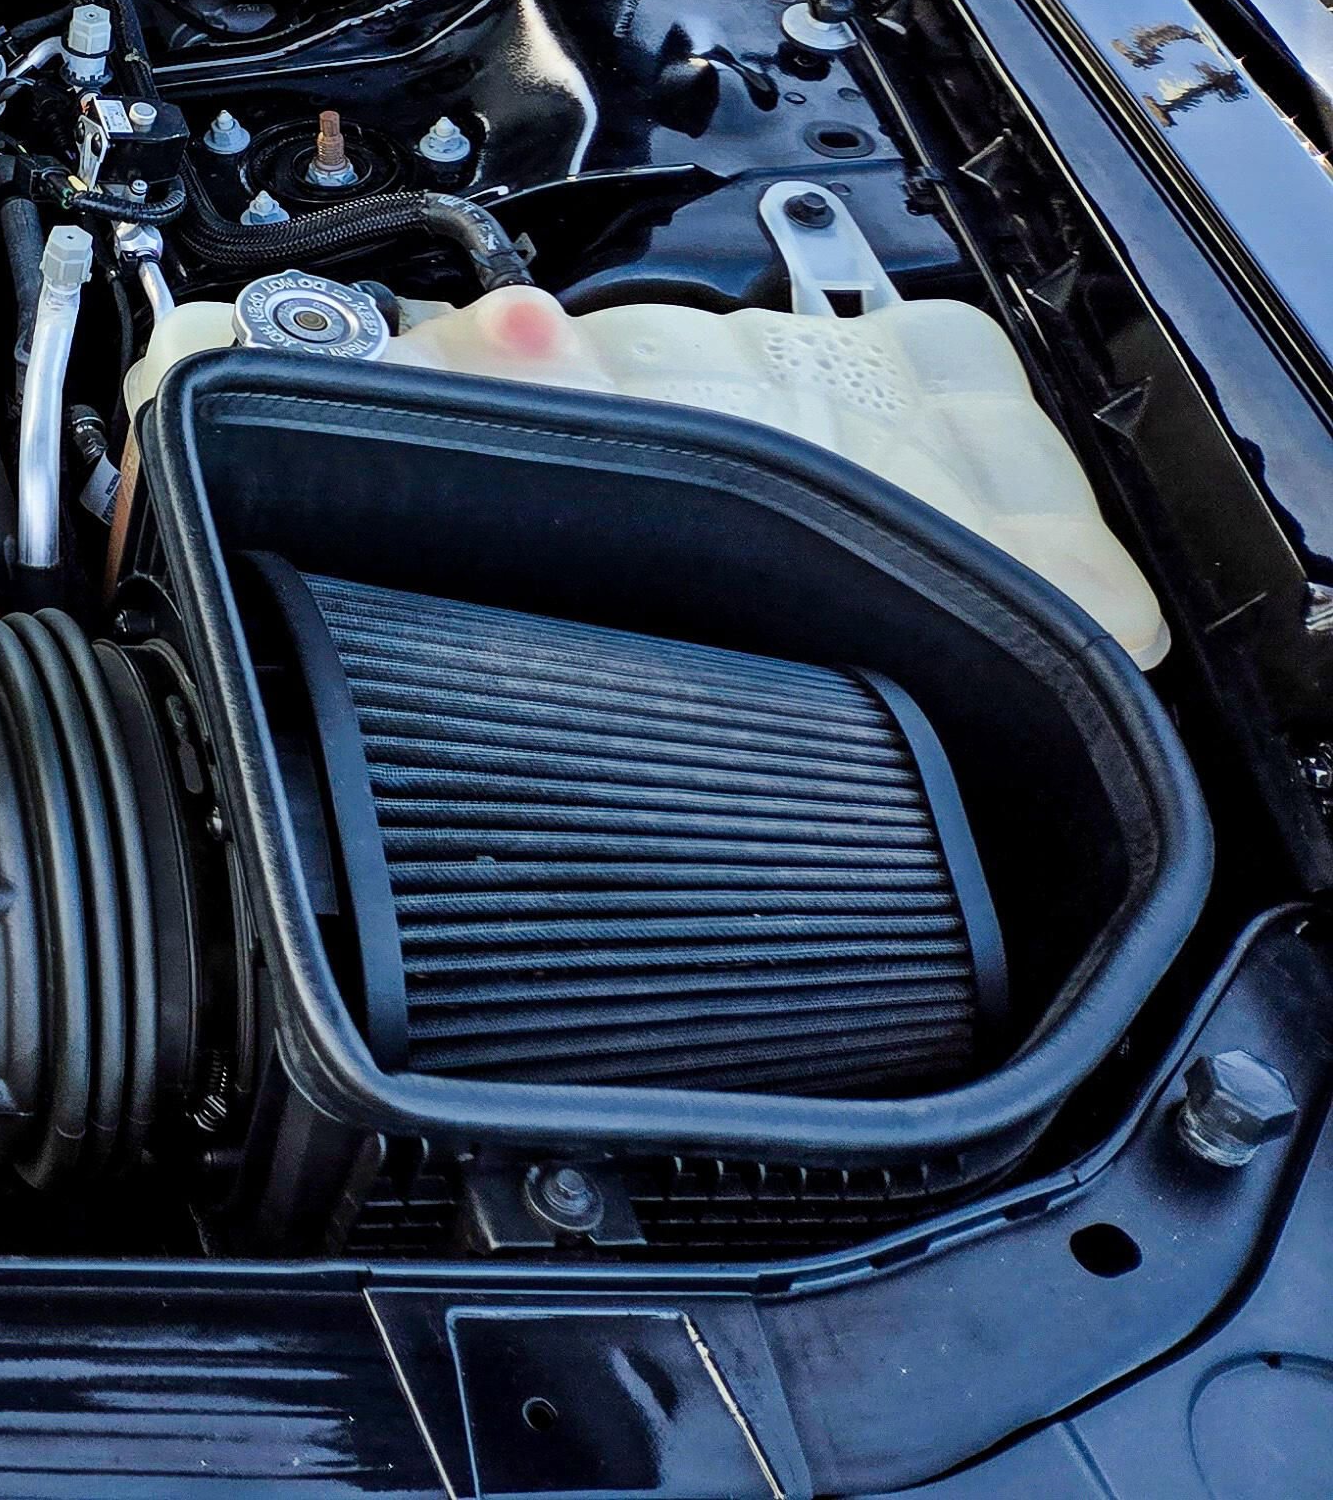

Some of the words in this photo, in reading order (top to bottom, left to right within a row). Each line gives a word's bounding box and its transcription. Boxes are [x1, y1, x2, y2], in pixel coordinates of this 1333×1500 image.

[261, 277, 296, 294] NOT
[297, 278, 327, 291] DO
[247, 292, 267, 322] OPEN
[355, 301, 379, 336] KEEP
[259, 325, 297, 348] HOT
[329, 338, 372, 358] TIGHT
